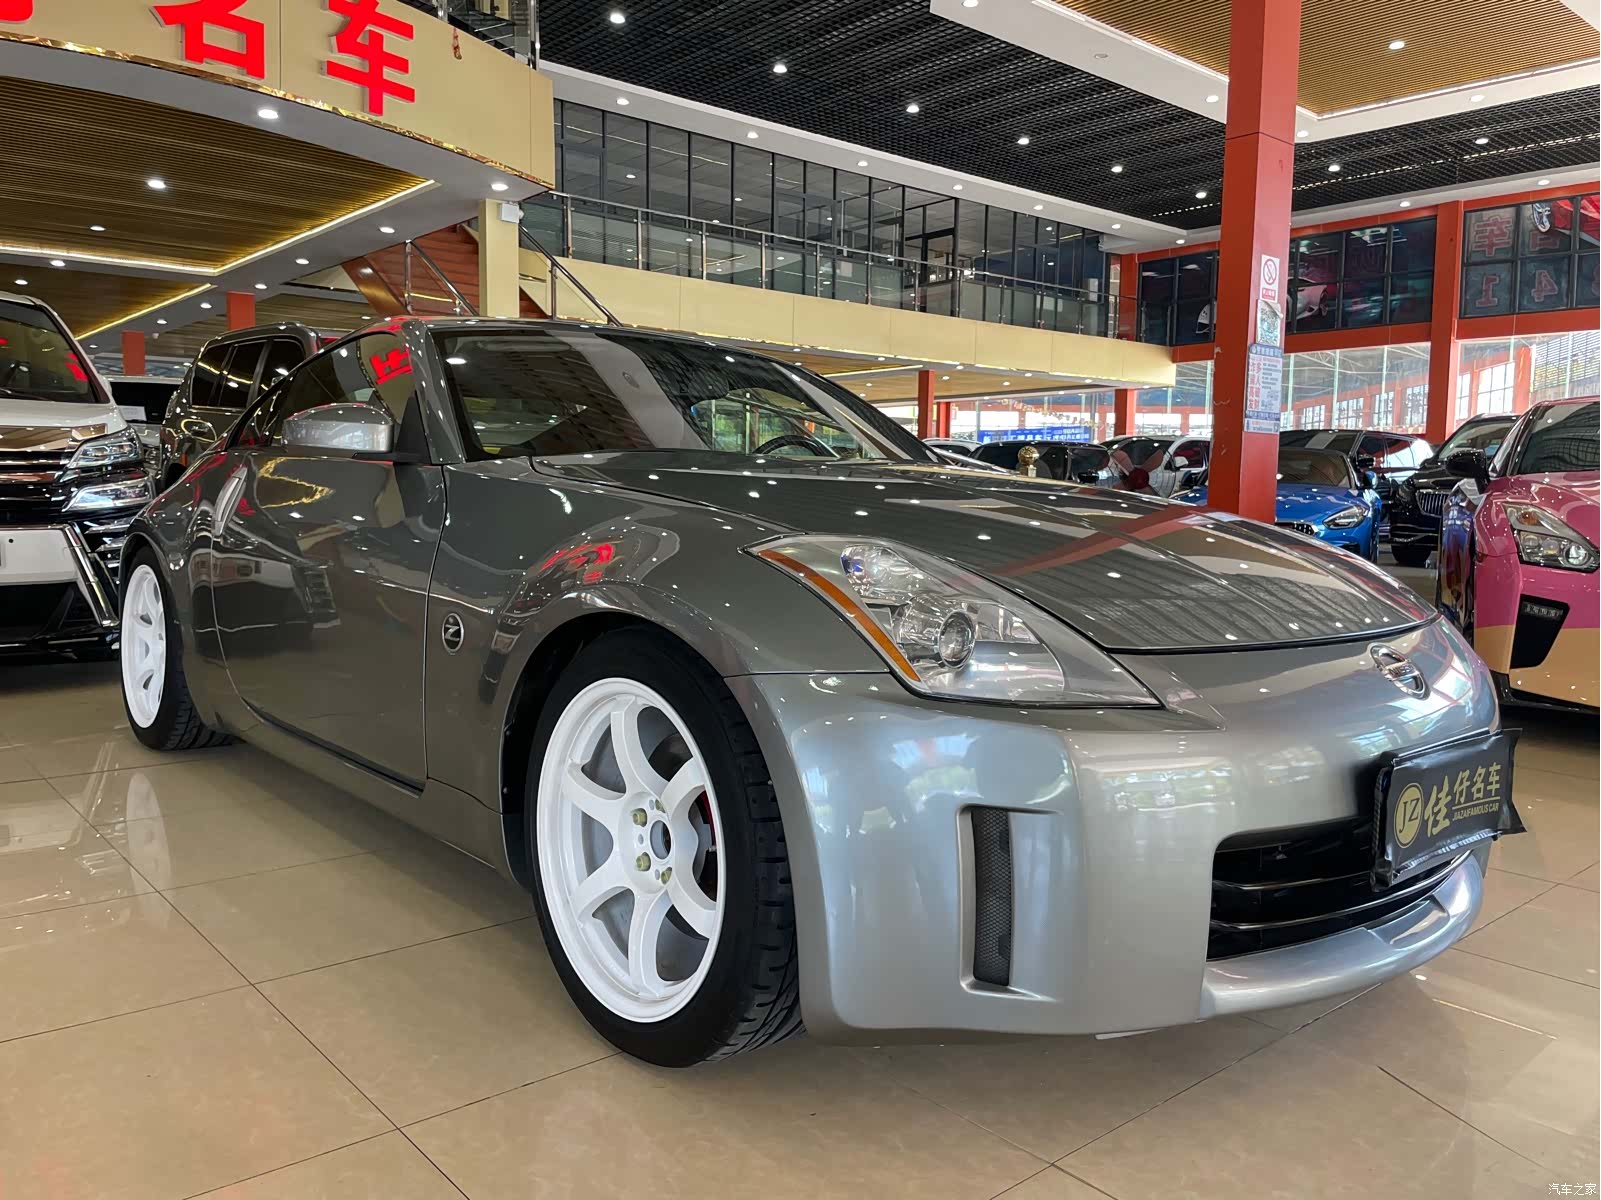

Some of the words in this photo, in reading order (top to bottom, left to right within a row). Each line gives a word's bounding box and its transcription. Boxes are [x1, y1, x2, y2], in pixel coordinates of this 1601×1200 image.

[445, 624, 460, 641] Z
[1398, 797, 1421, 834] JZ
[1424, 762, 1501, 838] 佳仔名车
